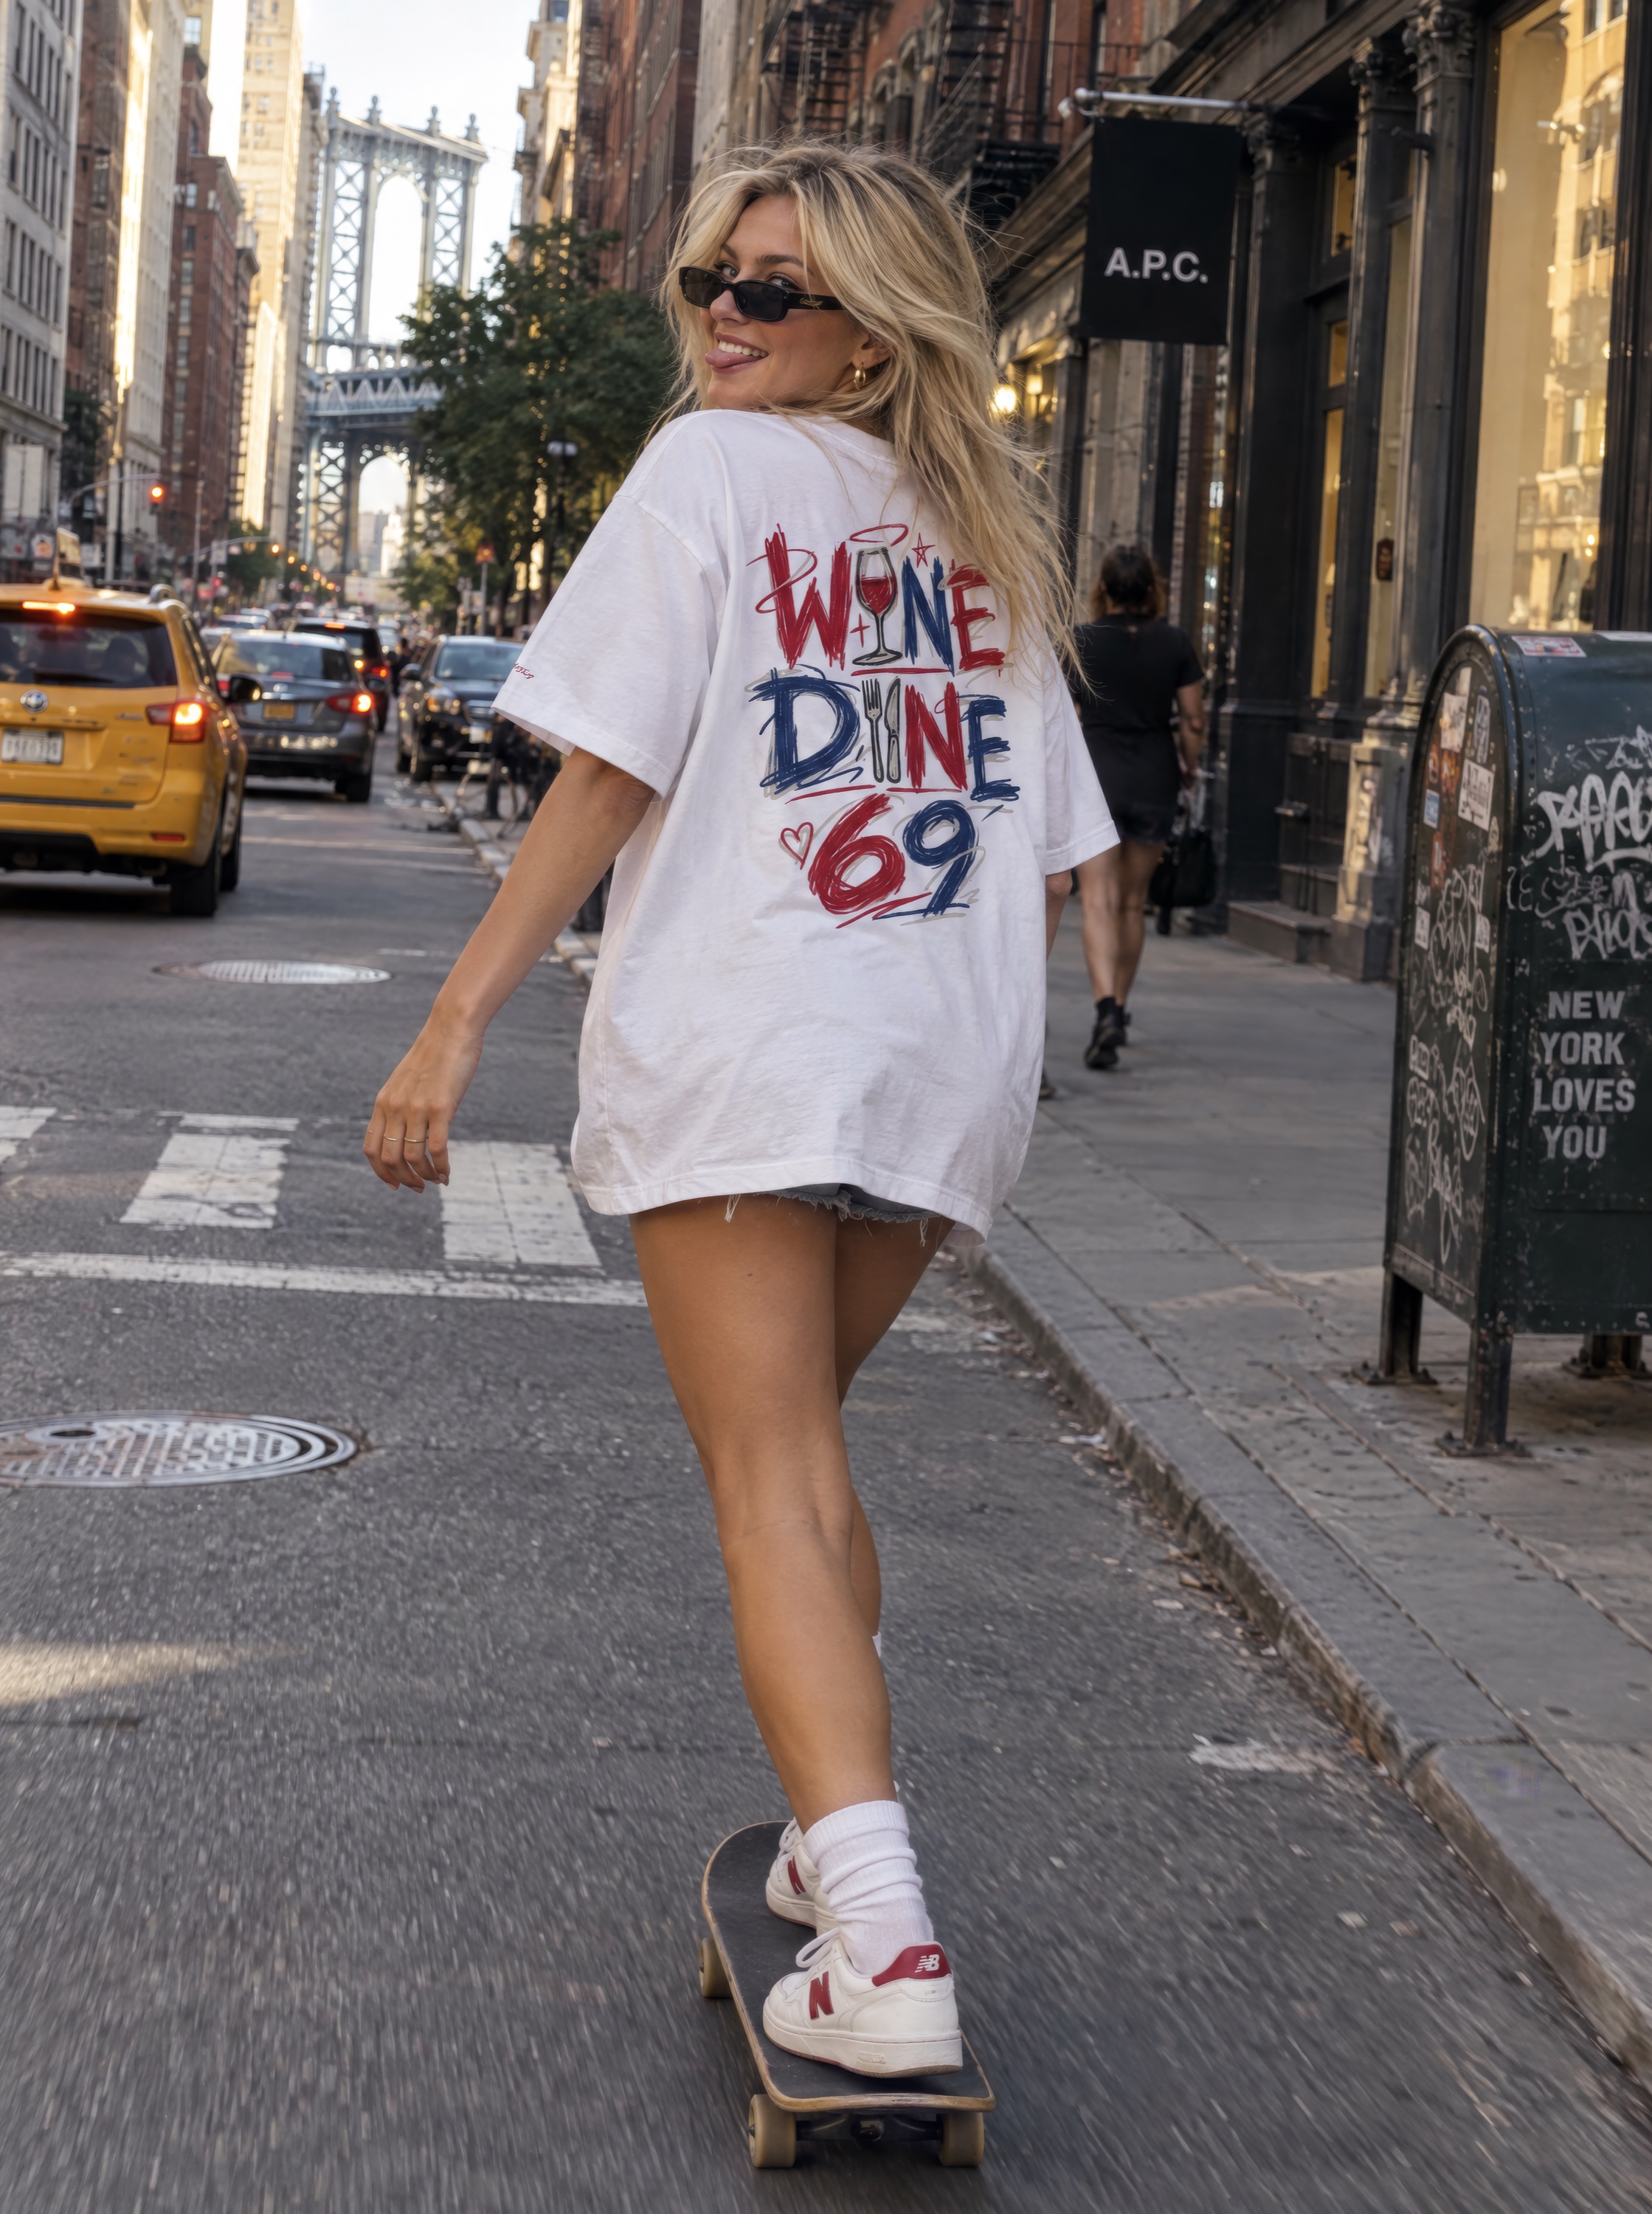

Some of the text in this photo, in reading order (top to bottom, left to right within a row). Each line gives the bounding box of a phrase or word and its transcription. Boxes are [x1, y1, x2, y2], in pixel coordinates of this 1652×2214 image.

[1104, 246, 1209, 283] A.P.C.
[808, 794, 978, 919] 69
[1548, 990, 1625, 1019] NEW
[1540, 1032, 1625, 1065] YORK
[1534, 1077, 1636, 1112] LOVES
[1542, 1125, 1608, 1160] YOU
[809, 1970, 834, 2021] N
